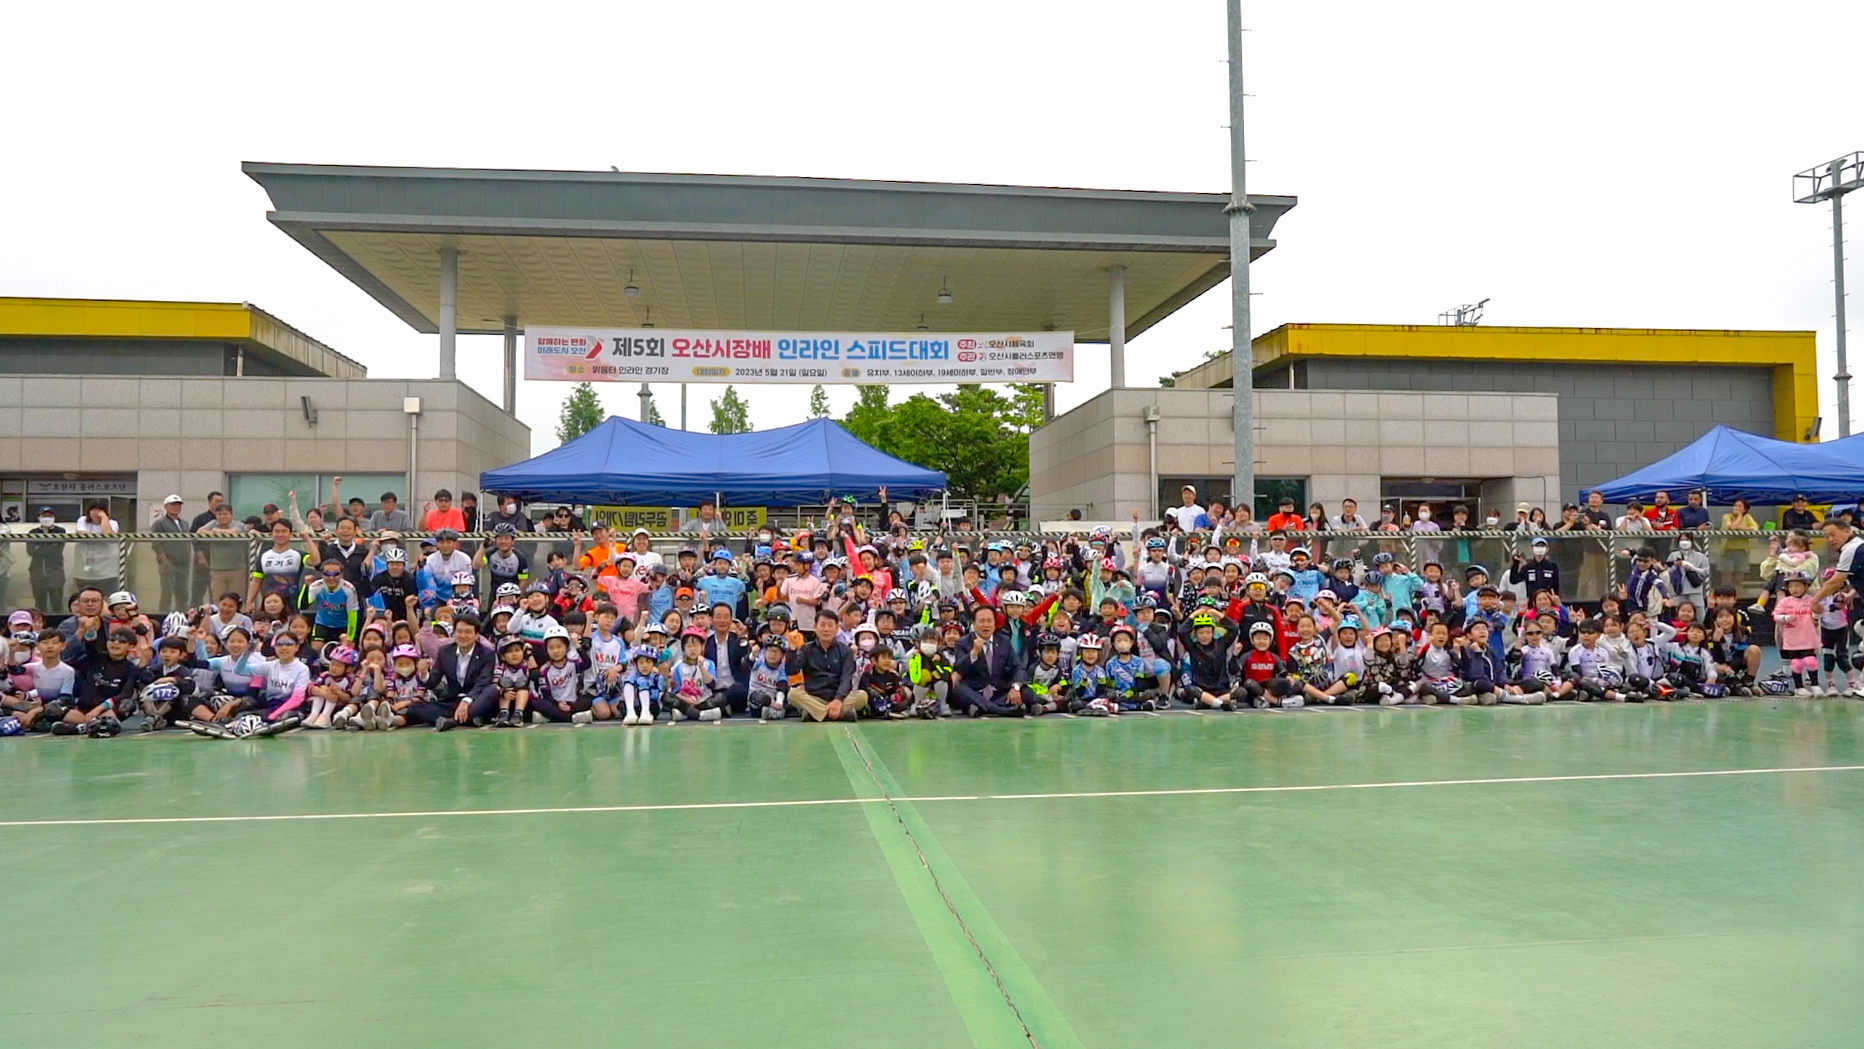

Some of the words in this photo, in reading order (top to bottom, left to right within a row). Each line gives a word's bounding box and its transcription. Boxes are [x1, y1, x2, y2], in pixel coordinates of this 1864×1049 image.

[571, 337, 587, 346] 변화
[537, 346, 569, 355] 미래도시
[571, 346, 587, 355] 오산
[612, 337, 665, 357] 제5회
[671, 338, 771, 359] 오산시장배
[778, 339, 839, 360] 인라인
[846, 339, 949, 360] 스피드대회
[618, 366, 643, 375] 인라인
[645, 366, 669, 375] 경기장
[735, 368, 763, 377] 2023년
[765, 368, 778, 377] 5월
[780, 368, 797, 377] 21일
[799, 368, 828, 377] (일요일)
[53, 482, 76, 492] 오산시
